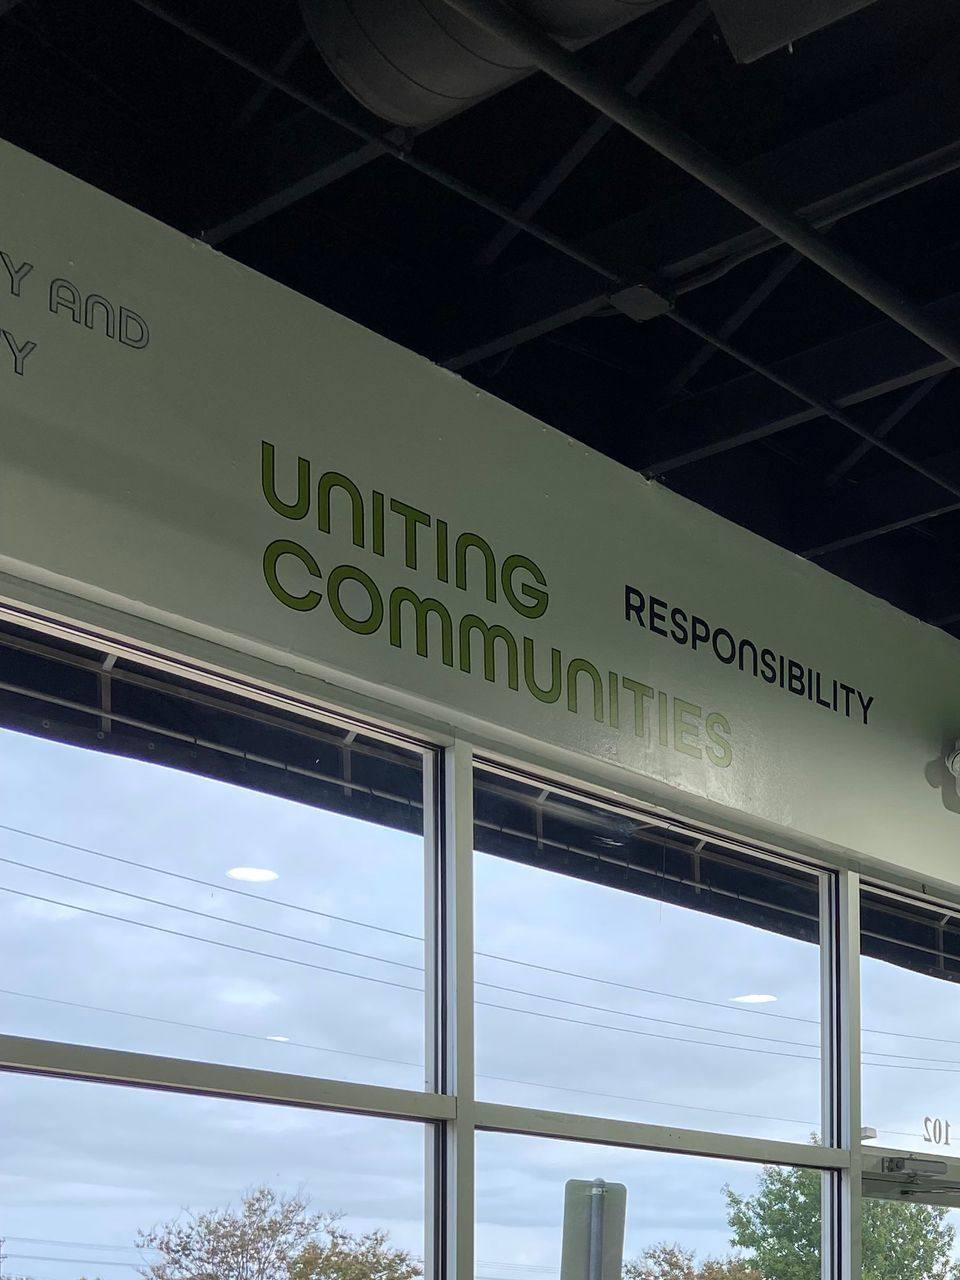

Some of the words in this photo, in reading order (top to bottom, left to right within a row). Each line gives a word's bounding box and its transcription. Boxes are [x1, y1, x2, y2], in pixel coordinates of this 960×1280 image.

[49, 278, 150, 350] AND
[261, 440, 549, 620] UNITING
[262, 539, 733, 769] COMMUNITIES
[624, 584, 874, 725] RESPONSIBILITY
